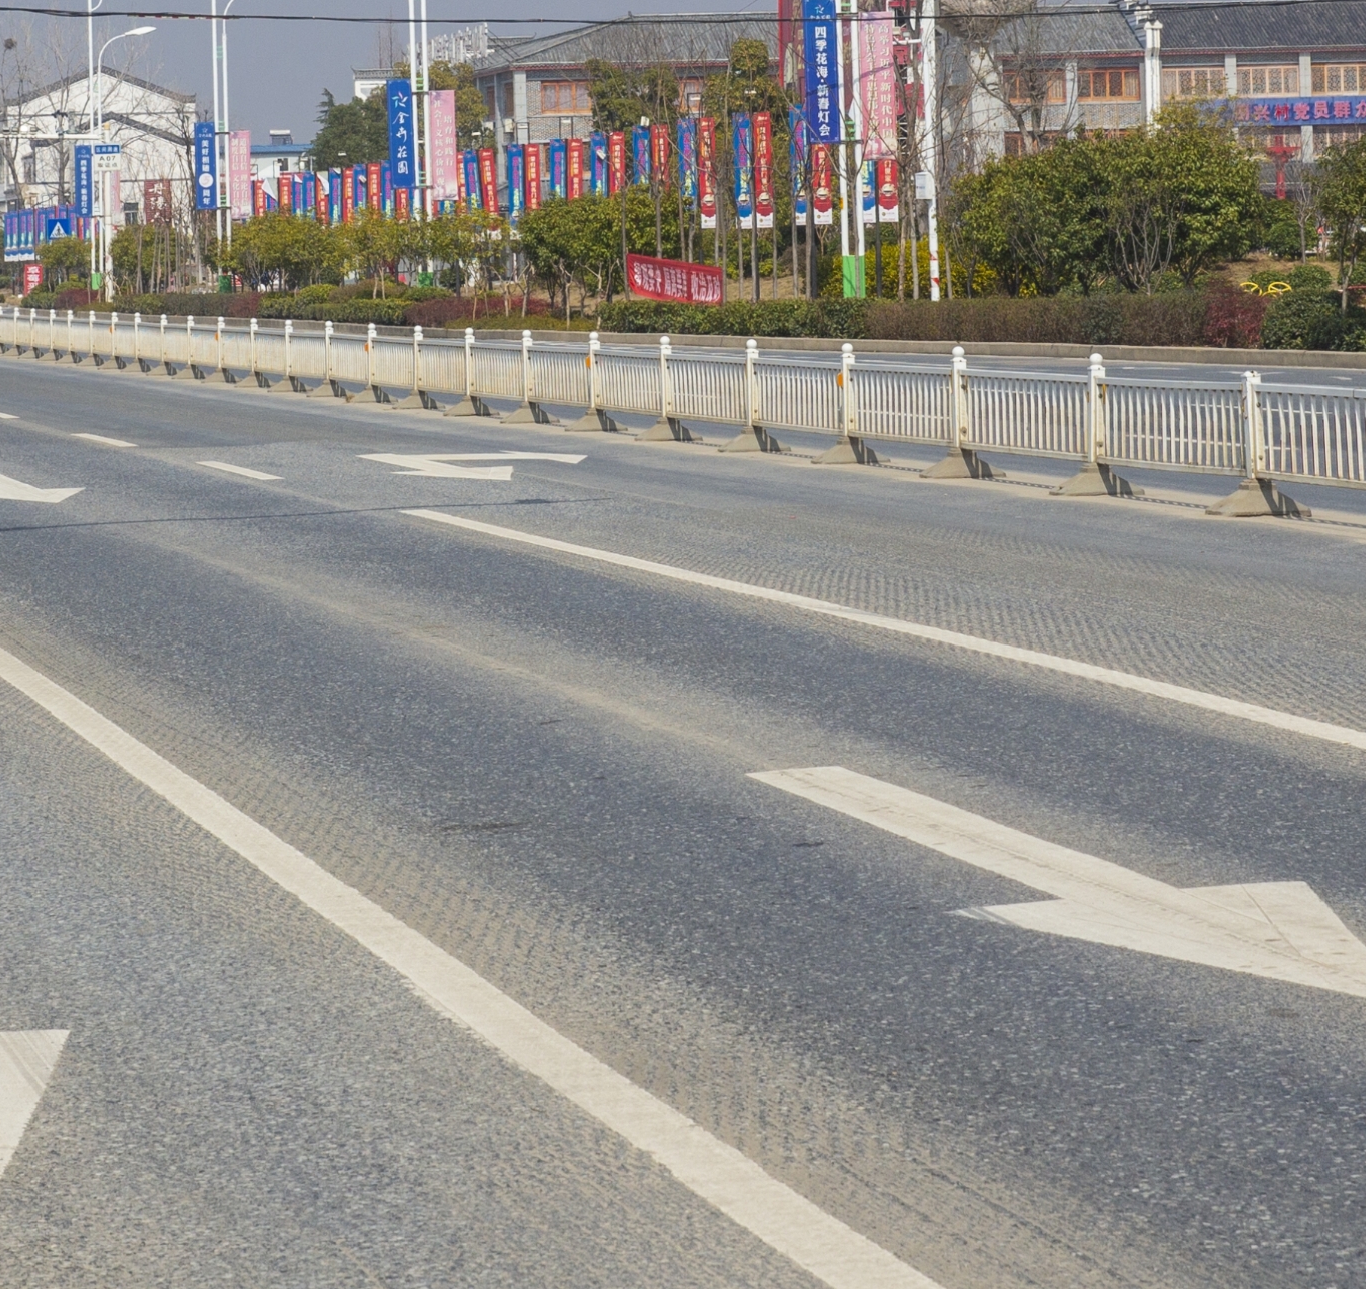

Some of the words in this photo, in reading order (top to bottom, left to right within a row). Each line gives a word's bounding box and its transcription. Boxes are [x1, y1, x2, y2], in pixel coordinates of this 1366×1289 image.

[814, 26, 830, 137] 四季花海·新春灯会
[878, 24, 893, 138] 高举习近平新时代中国
[434, 100, 445, 186] 社会主义核心价值观
[444, 115, 454, 166] 培育和践行
